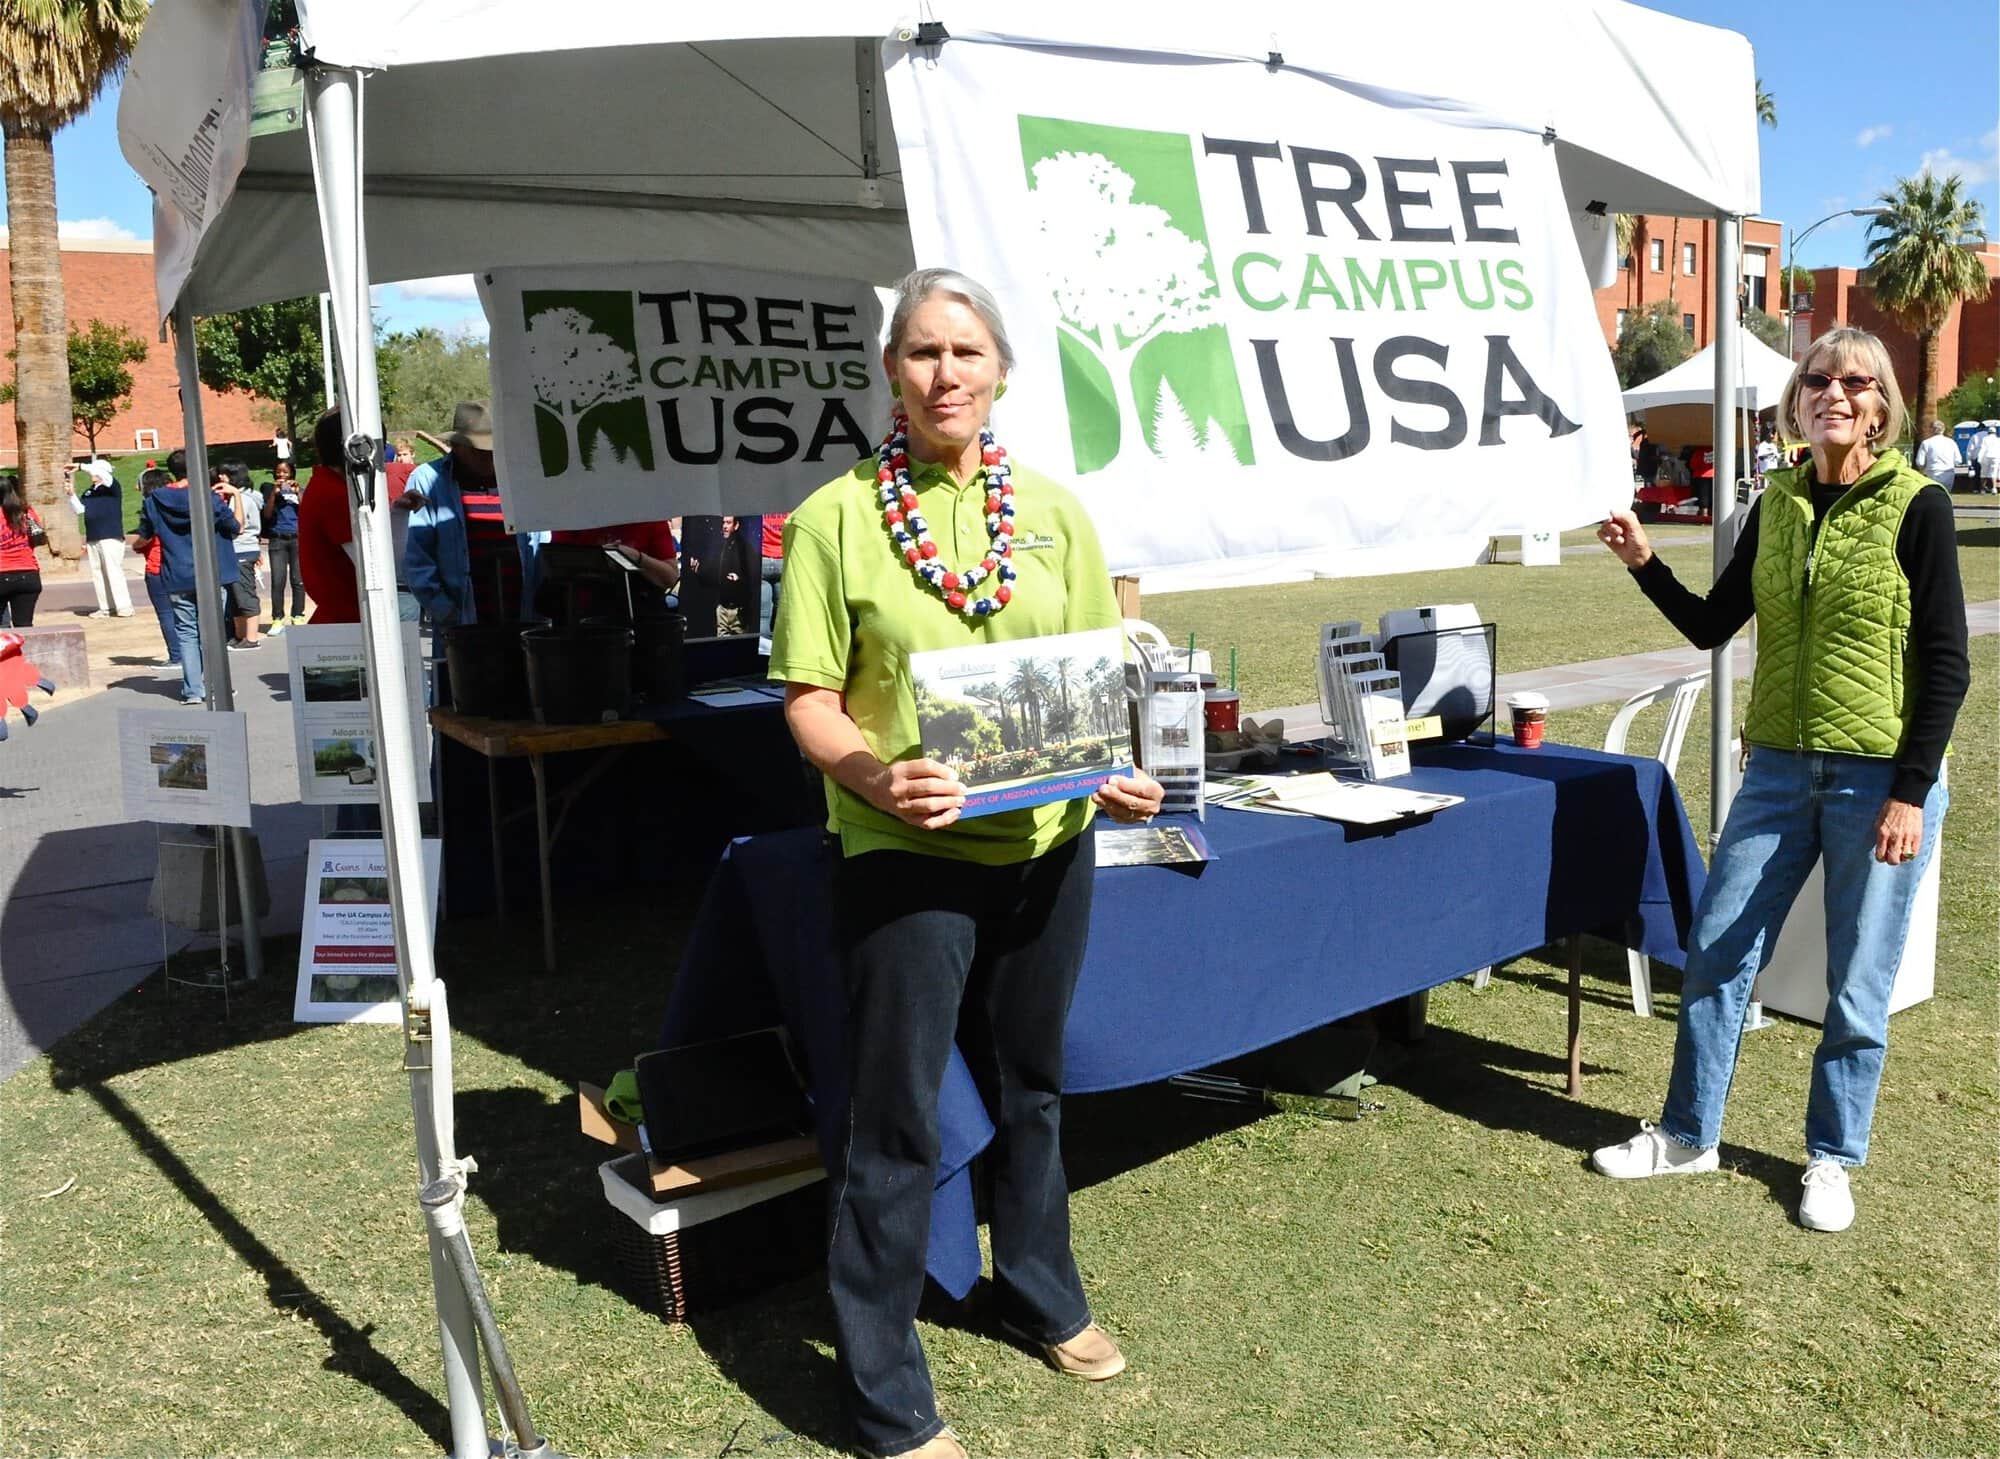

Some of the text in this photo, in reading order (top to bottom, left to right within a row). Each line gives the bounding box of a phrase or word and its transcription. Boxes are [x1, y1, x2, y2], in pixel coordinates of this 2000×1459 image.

[1202, 132, 1520, 245] TREE
[1231, 251, 1534, 312] CAMPUS
[638, 289, 864, 352] TREE
[649, 355, 871, 392] CAMPUS
[1248, 334, 1583, 462] USA
[656, 396, 874, 465] USA
[332, 728, 357, 737] Adopt
[1003, 788, 1040, 802] ARIZONA
[1041, 780, 1076, 795] CAMPUS
[358, 911, 382, 920] Campus
